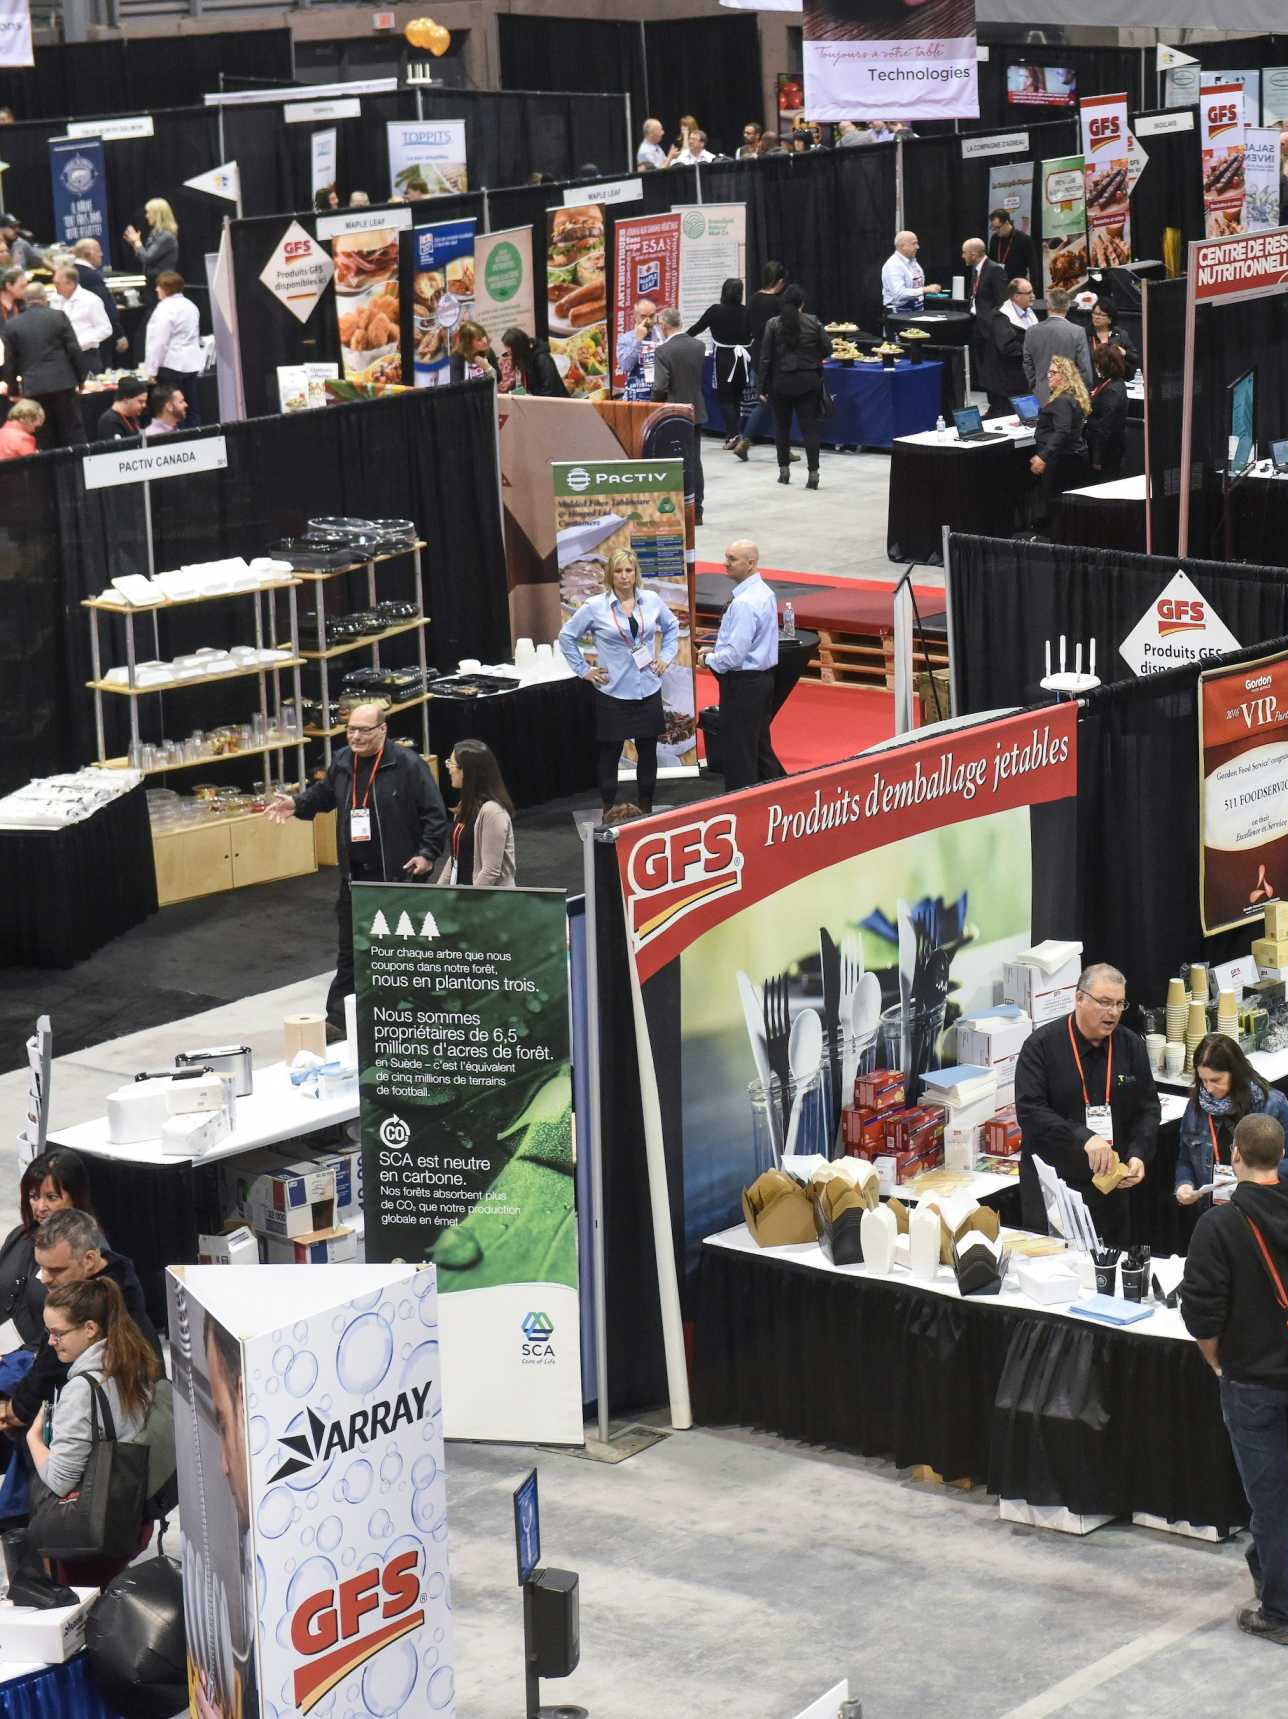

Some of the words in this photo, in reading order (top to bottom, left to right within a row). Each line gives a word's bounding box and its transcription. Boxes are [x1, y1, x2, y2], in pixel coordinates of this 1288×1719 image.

[867, 66, 971, 82] Technologies
[1208, 104, 1237, 124] GFS
[1088, 115, 1120, 137] GFS
[284, 239, 312, 254] GFS
[642, 237, 666, 253] ESA
[1199, 241, 1247, 267] CENTRE
[1247, 239, 1264, 259] DE
[276, 267, 309, 279] Produits
[274, 276, 318, 291] disponibles
[118, 458, 155, 473] PACTIV
[155, 451, 197, 467] CANADA
[595, 472, 669, 484] PACTIV
[1157, 598, 1205, 622] GFS
[1143, 643, 1196, 660] Produits
[1245, 675, 1272, 690] Gordon
[1240, 695, 1278, 729] VIP
[764, 790, 860, 846] Produits
[864, 752, 988, 815] d'emballage
[991, 727, 1070, 792] jetables
[1224, 797, 1238, 812] 511
[631, 818, 736, 893] GFS
[370, 946, 394, 957] Pour
[396, 947, 434, 961] chaque
[436, 948, 463, 960] arbre
[464, 951, 484, 963] que
[486, 951, 512, 962] nous
[371, 961, 415, 973] coupons
[417, 961, 442, 973] dans
[443, 963, 470, 974] notre
[472, 963, 498, 976] forêt,
[372, 975, 409, 988] nous
[412, 977, 431, 988] en
[435, 974, 500, 992] plantons
[503, 977, 540, 993] trois.
[373, 1007, 413, 1023] Nous
[417, 1011, 481, 1025] sommes
[374, 1024, 466, 1043] propriétaires
[469, 1028, 489, 1042] de
[493, 1028, 518, 1044] 6,5
[375, 1041, 429, 1056] millions
[432, 1043, 488, 1058] d'acres
[492, 1044, 512, 1059] de
[516, 1045, 554, 1061] forêt.
[375, 1059, 389, 1068] en
[391, 1058, 423, 1069] Suède
[433, 1060, 458, 1071] c'est
[460, 1061, 516, 1073] l'équivalent
[376, 1071, 389, 1082] de
[391, 1072, 413, 1085] cinq
[414, 1073, 451, 1084] millions
[453, 1074, 467, 1085] de
[468, 1076, 507, 1087] terrains
[376, 1086, 390, 1096] de
[391, 1085, 431, 1098] football.
[379, 1152, 414, 1168] SCA
[417, 1155, 440, 1169] est
[443, 1156, 491, 1171] neutre
[380, 1171, 399, 1183] en
[402, 1169, 467, 1186] carbone.
[381, 1186, 400, 1197] Nos
[403, 1186, 431, 1198] forêts
[433, 1188, 483, 1200] absorbent
[485, 1190, 507, 1202] plus
[381, 1199, 394, 1210] de
[418, 1203, 438, 1214] que
[439, 1203, 466, 1213] notre
[467, 1203, 521, 1216] production
[381, 1213, 417, 1226] globale
[419, 1216, 433, 1225] en
[521, 1344, 556, 1357] SCA
[323, 1380, 433, 1461] ARRAY
[290, 1551, 421, 1656] GFS
